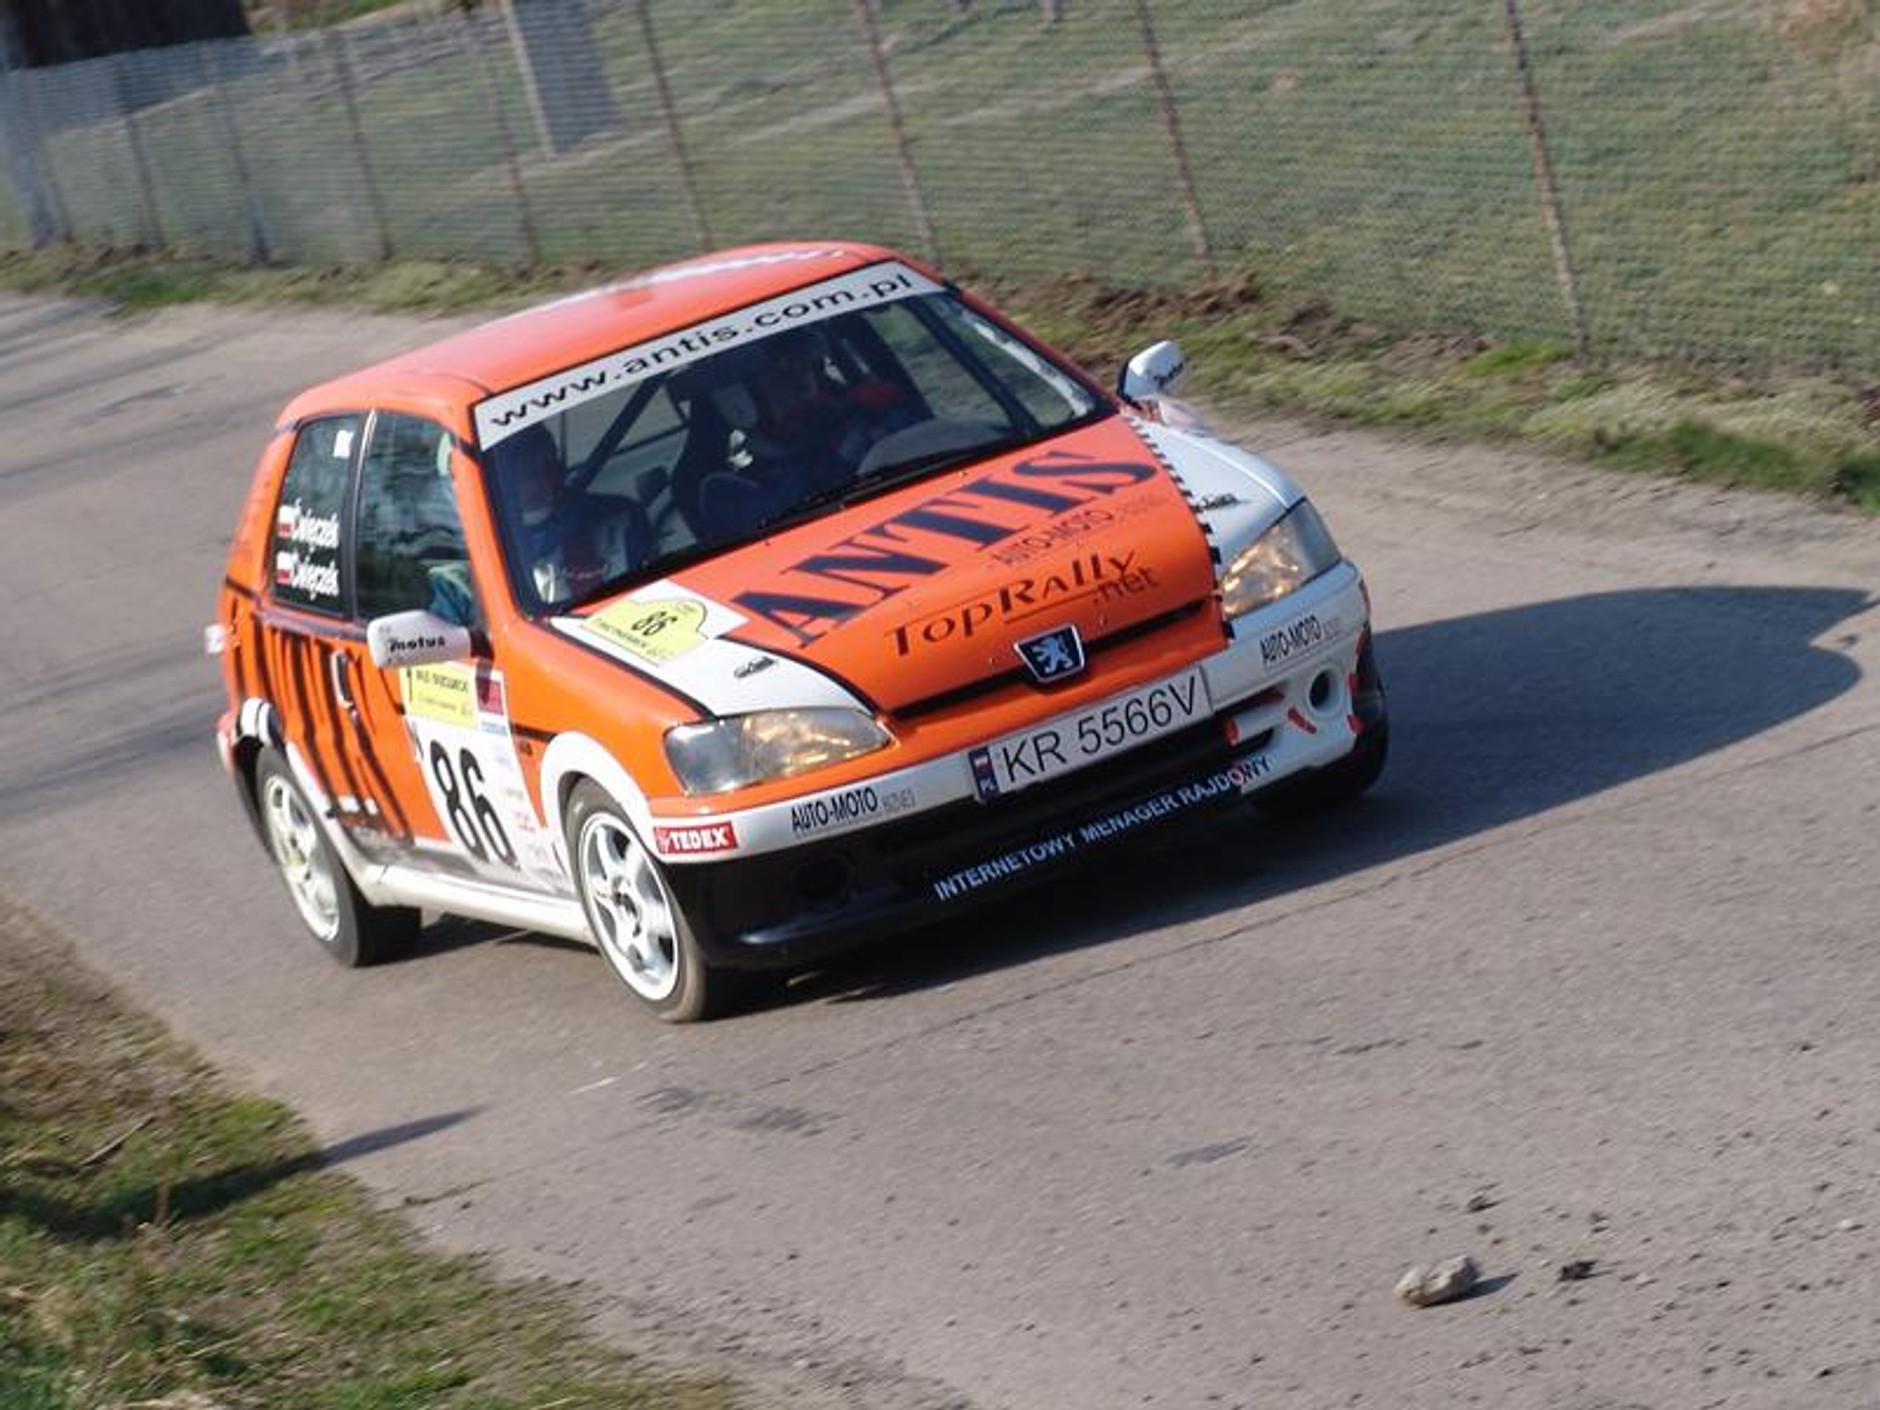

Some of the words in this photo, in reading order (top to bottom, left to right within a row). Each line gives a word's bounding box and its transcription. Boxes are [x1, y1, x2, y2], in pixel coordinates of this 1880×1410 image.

[492, 273, 914, 427] www.antis.com.pl
[730, 450, 1159, 647] ANTIS
[631, 610, 679, 637] 86
[1002, 730, 1068, 783] KR
[1077, 675, 1196, 755] 5566V
[429, 739, 521, 872] 86
[668, 825, 730, 851] TEDEX
[791, 786, 878, 834] AUTO-MOTO
[934, 832, 1076, 900] INTERNETOWY
[1080, 796, 1179, 845] MENAGER
[1176, 754, 1271, 806] RAJDOWY
[979, 775, 996, 793] PL
